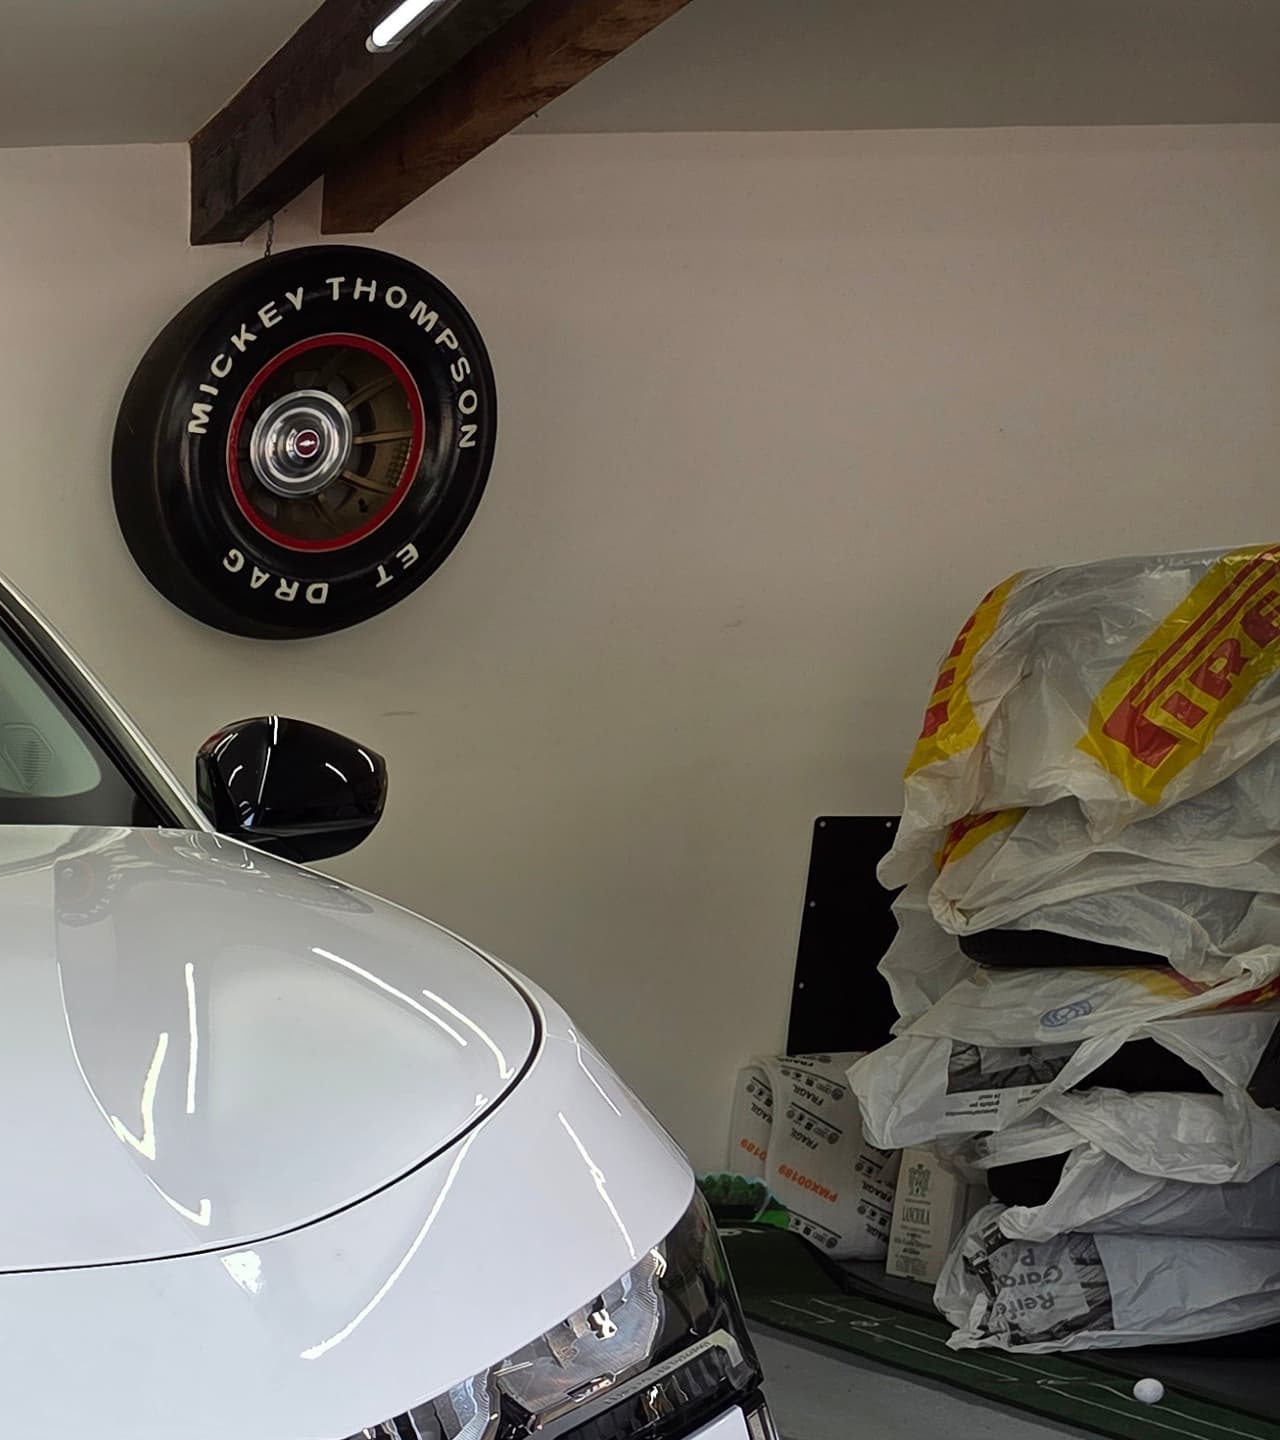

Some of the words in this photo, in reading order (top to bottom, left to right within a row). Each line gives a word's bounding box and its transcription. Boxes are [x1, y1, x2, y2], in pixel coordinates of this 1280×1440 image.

[188, 287, 305, 434] MICKEY
[326, 276, 478, 449] THOMPSON
[223, 549, 329, 604] DRAG
[375, 542, 420, 588] ET
